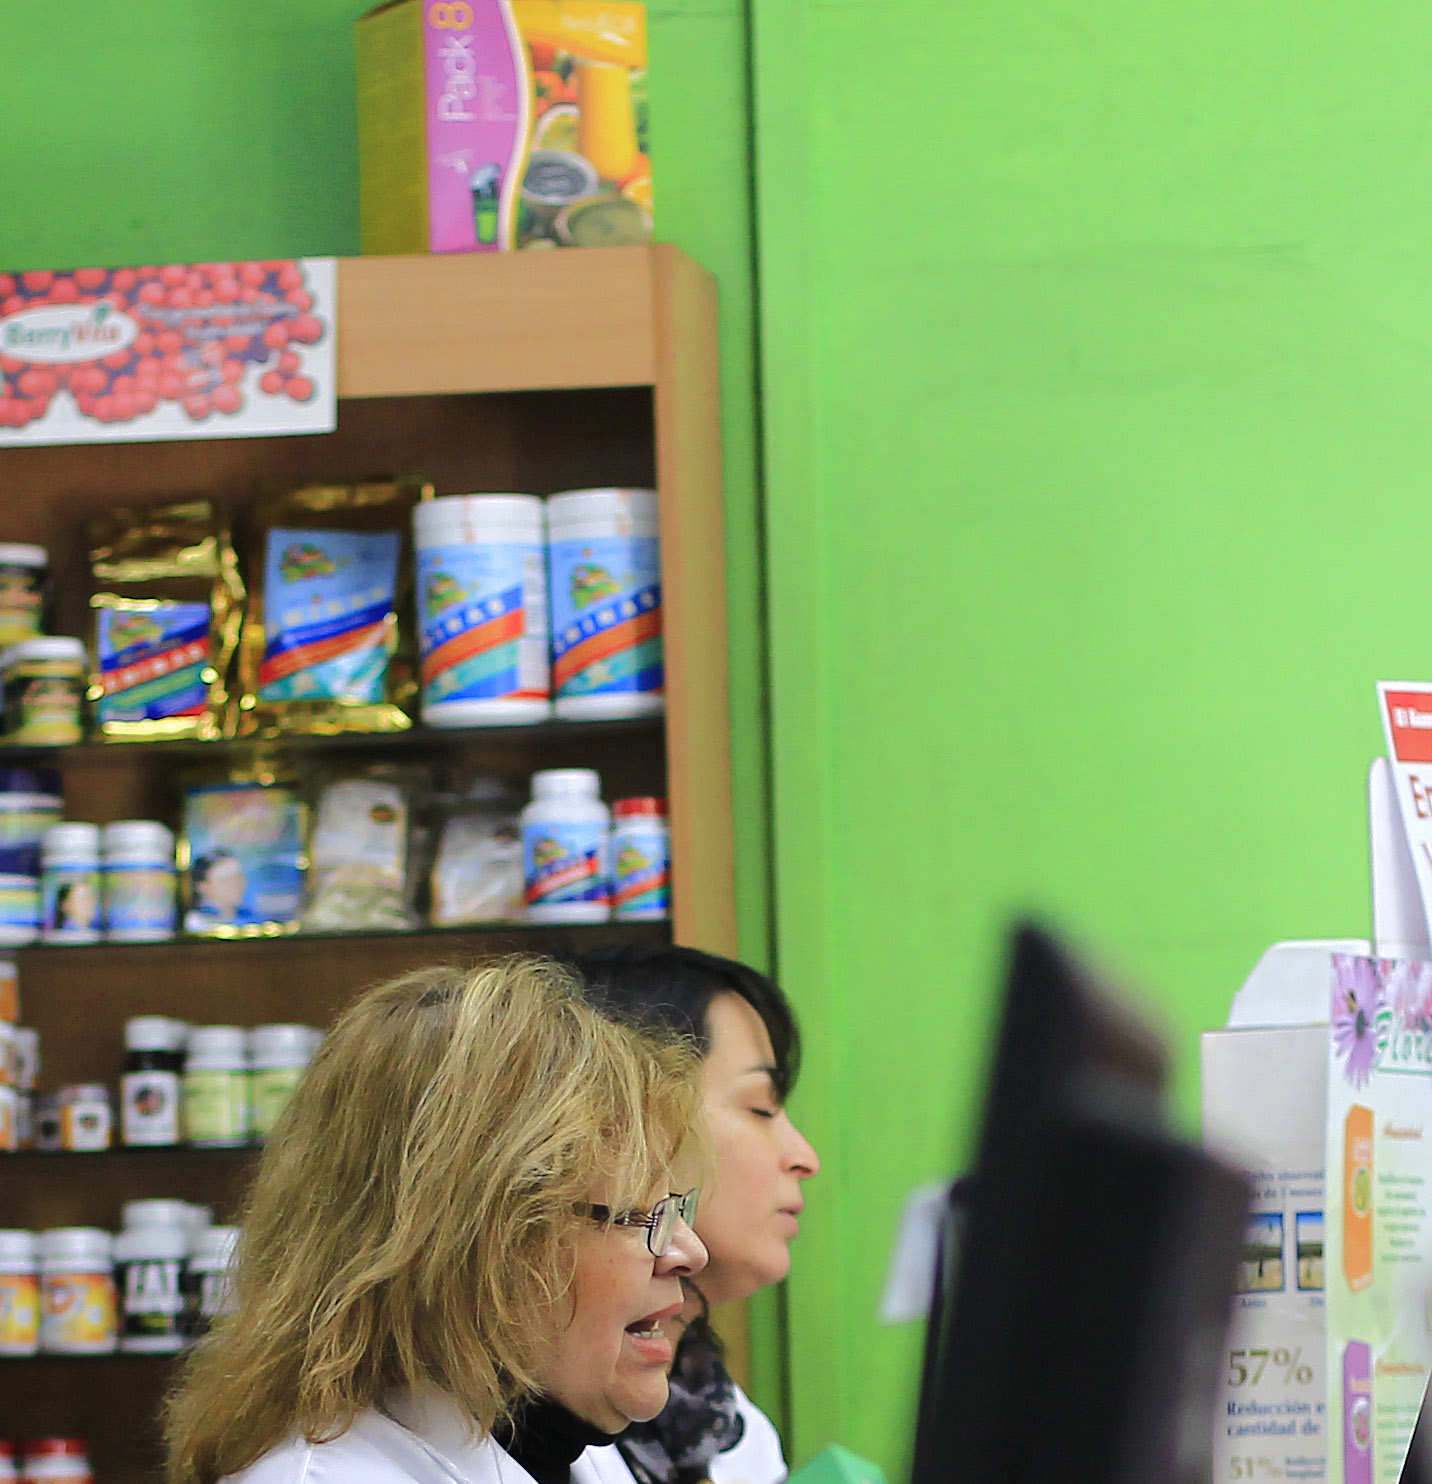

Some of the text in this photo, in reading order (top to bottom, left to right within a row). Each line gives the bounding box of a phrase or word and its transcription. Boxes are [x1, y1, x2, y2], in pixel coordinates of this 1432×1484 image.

[437, 34, 477, 122] Pack
[1227, 1346, 1313, 1388] 57%
[1227, 1399, 1312, 1416] Reducción
[1227, 1419, 1320, 1436] cantidad de
[1229, 1456, 1283, 1479] 51%
